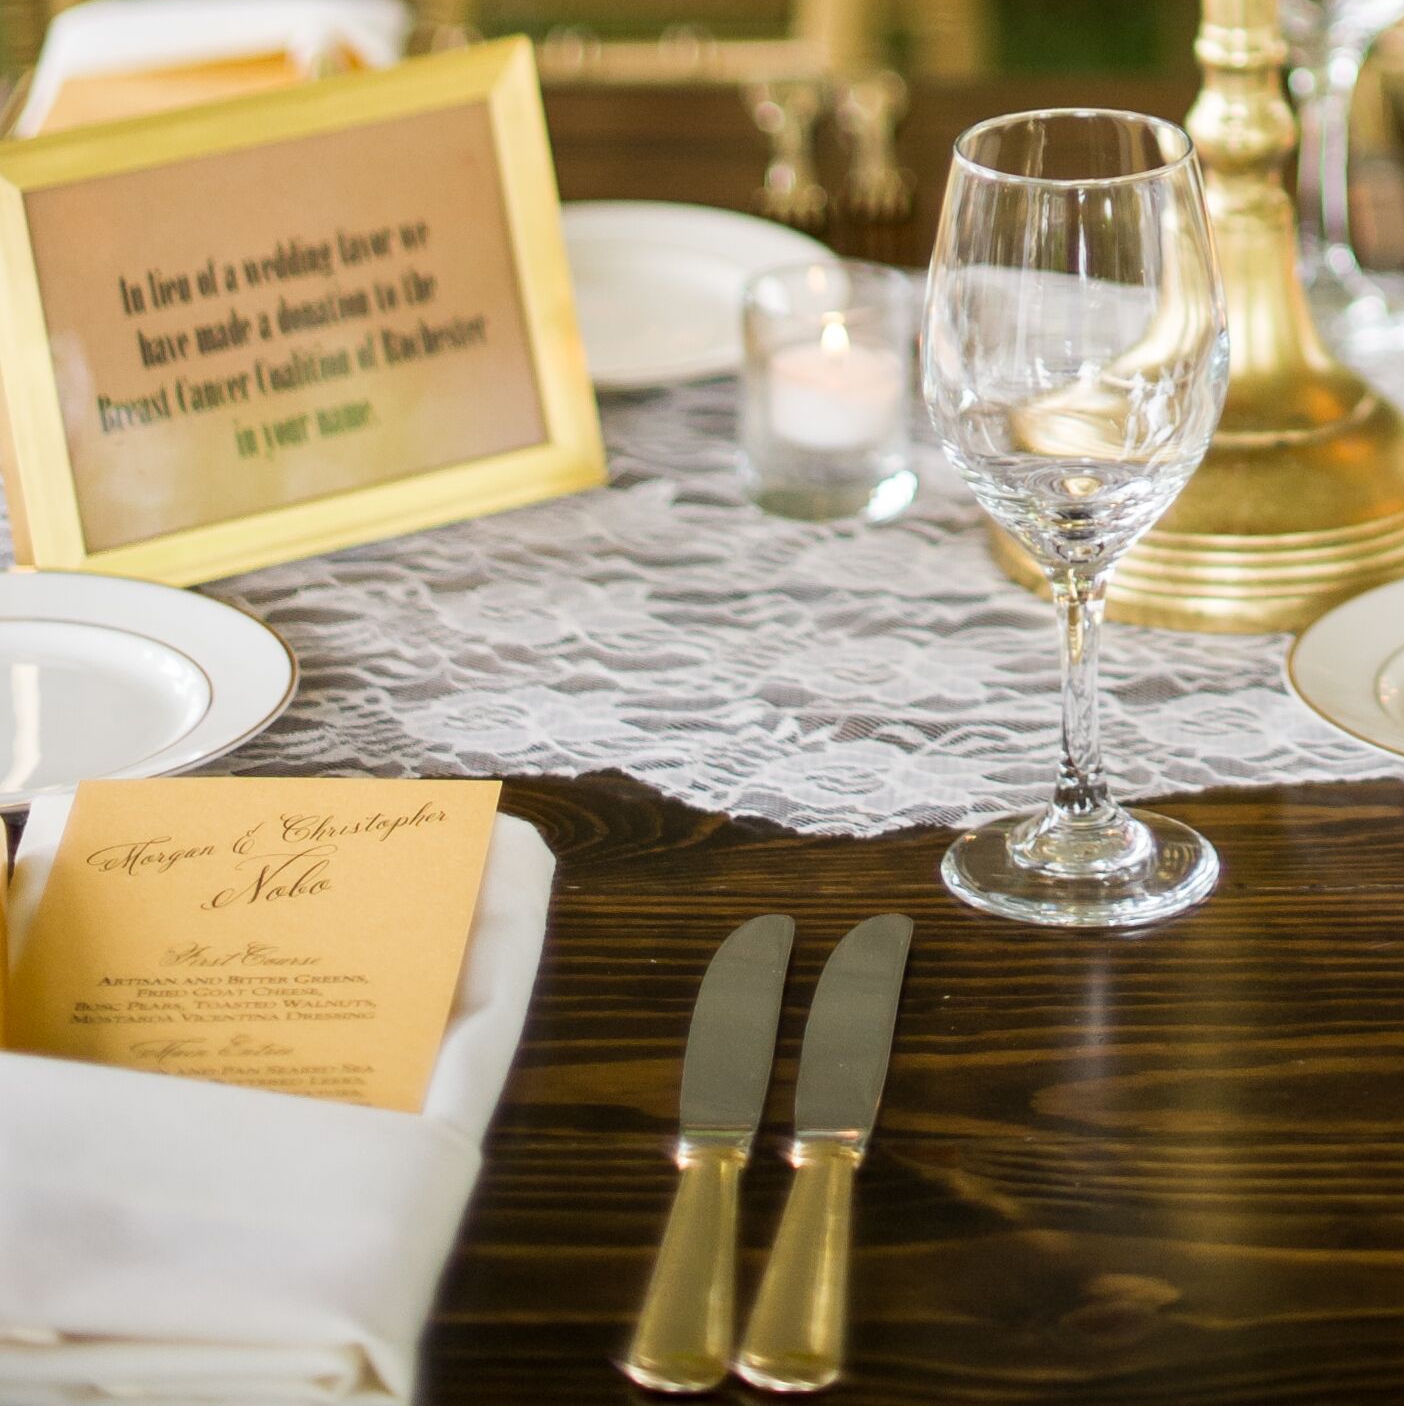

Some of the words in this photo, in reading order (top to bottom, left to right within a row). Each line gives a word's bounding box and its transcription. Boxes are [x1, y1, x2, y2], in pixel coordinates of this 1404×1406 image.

[118, 274, 146, 316] In
[148, 268, 192, 309] lieu
[197, 257, 218, 297] of
[225, 263, 238, 293] a
[243, 238, 331, 287] wedding
[337, 226, 391, 267] favor
[399, 222, 427, 250] we
[138, 329, 188, 369] have
[195, 306, 249, 355] made
[258, 312, 271, 340] a
[277, 288, 369, 334] donation
[373, 283, 396, 313] to
[401, 267, 437, 306] the
[98, 384, 171, 433] Breast
[175, 373, 248, 413] Cancer
[254, 348, 350, 394] Coalition
[357, 334, 378, 371] of
[381, 314, 486, 366] Rochester
[234, 419, 258, 458] in
[261, 411, 308, 461] your
[86, 836, 214, 877] Morgan
[280, 801, 448, 842] Christopher
[200, 844, 338, 910] Nobo
[159, 941, 241, 967] First
[241, 941, 322, 967] Course
